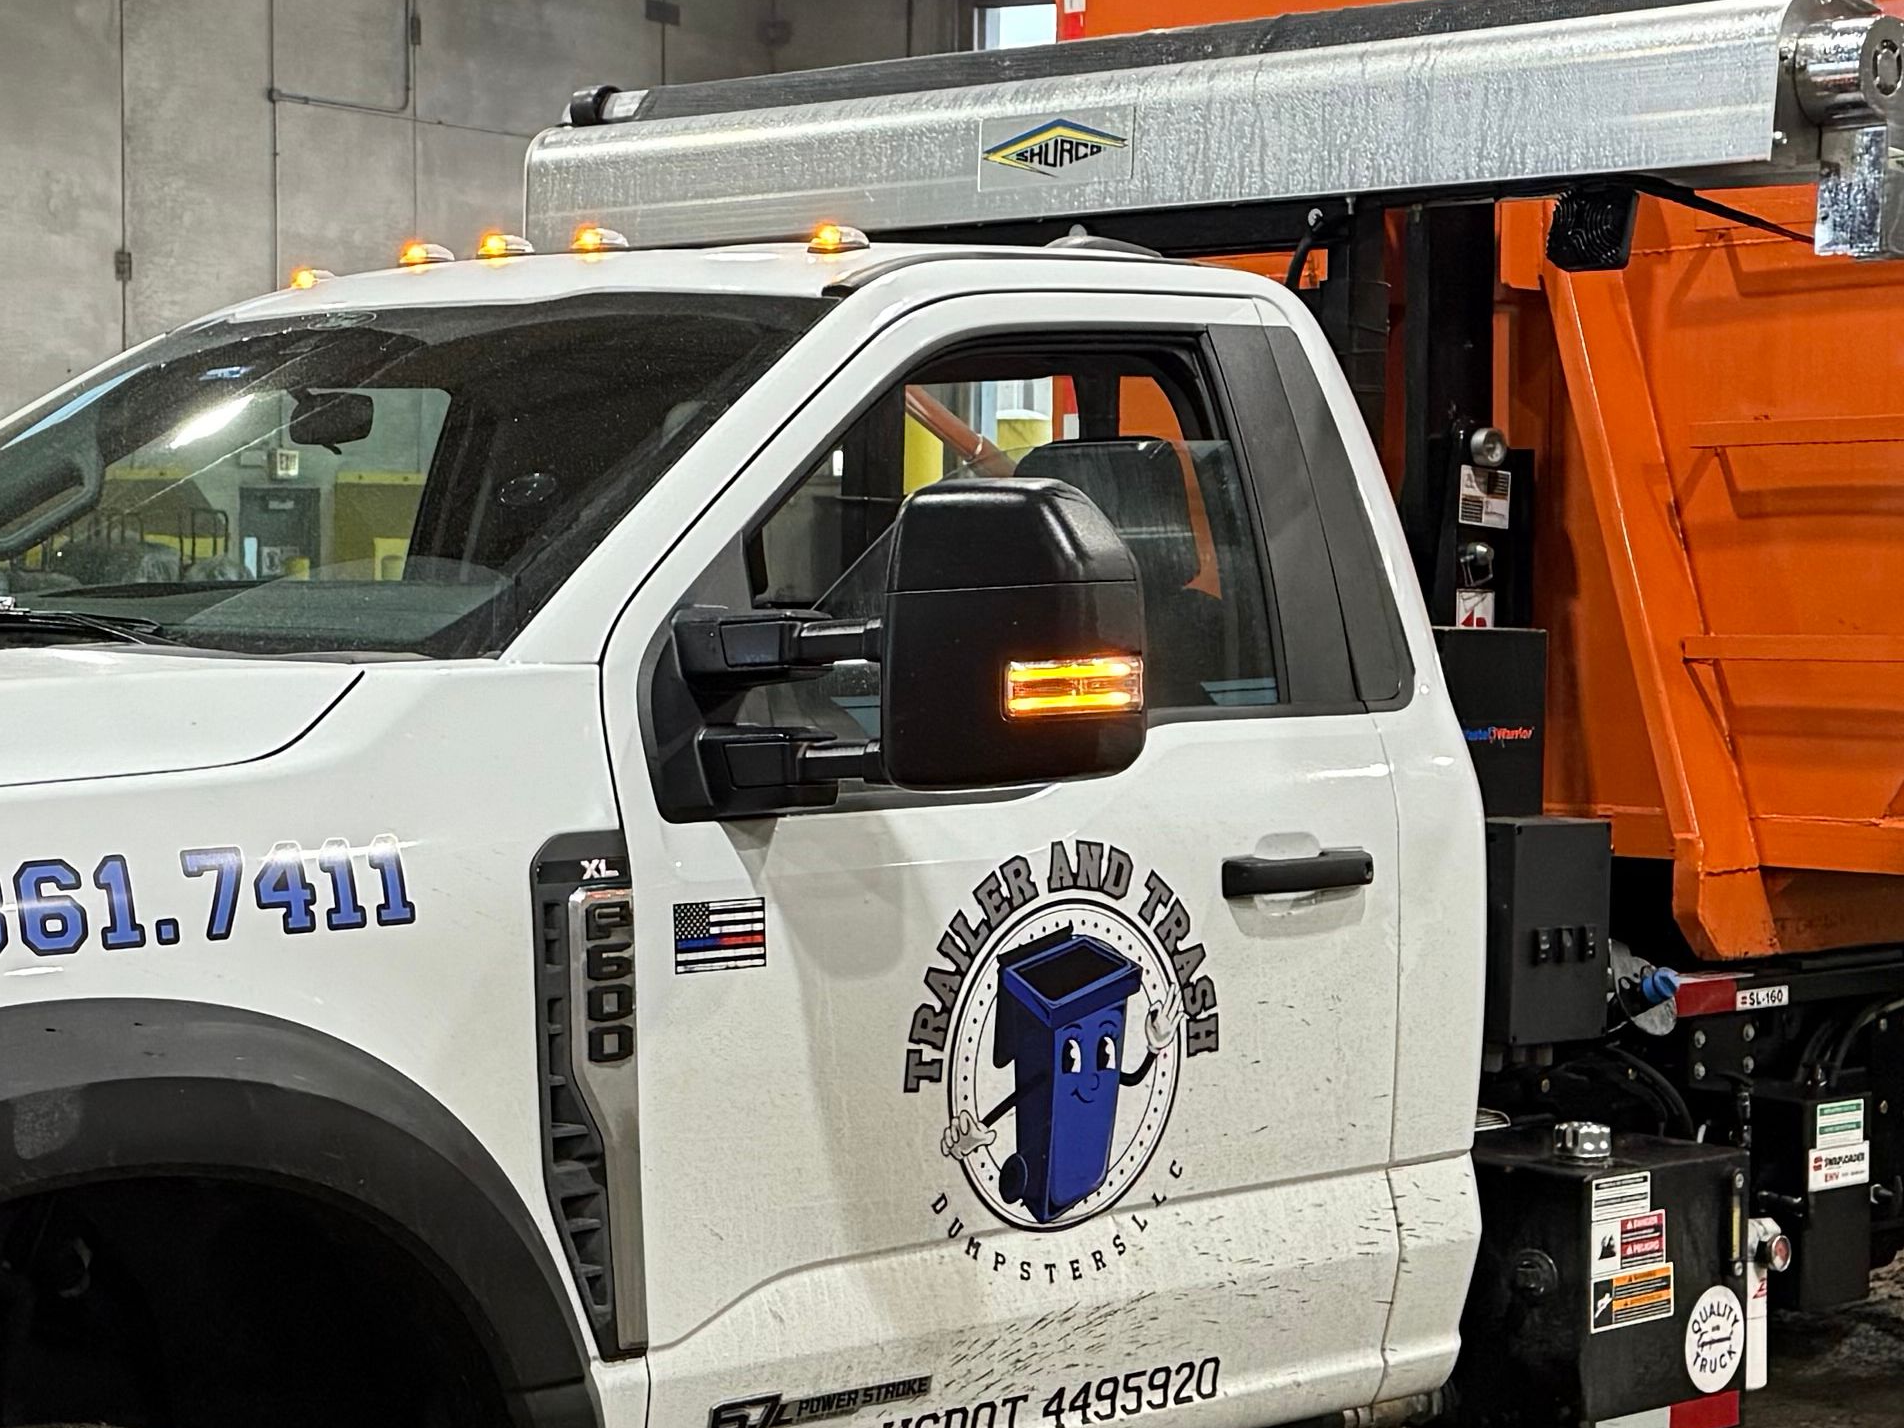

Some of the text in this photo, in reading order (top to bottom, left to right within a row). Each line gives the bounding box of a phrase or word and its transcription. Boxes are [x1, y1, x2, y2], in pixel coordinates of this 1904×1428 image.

[1015, 138, 1102, 168] SHURCO
[580, 858, 619, 880] XL
[903, 839, 1220, 1094] TRAILER AND TRASH
[1748, 989, 1784, 1007] SL-160
[930, 1158, 1185, 1284] DUMPSTERS LLC
[1691, 1300, 1741, 1336] QUALITY
[1692, 1348, 1738, 1374] TRUCK
[796, 1390, 859, 1417] POWER
[861, 1376, 930, 1404] STROKE
